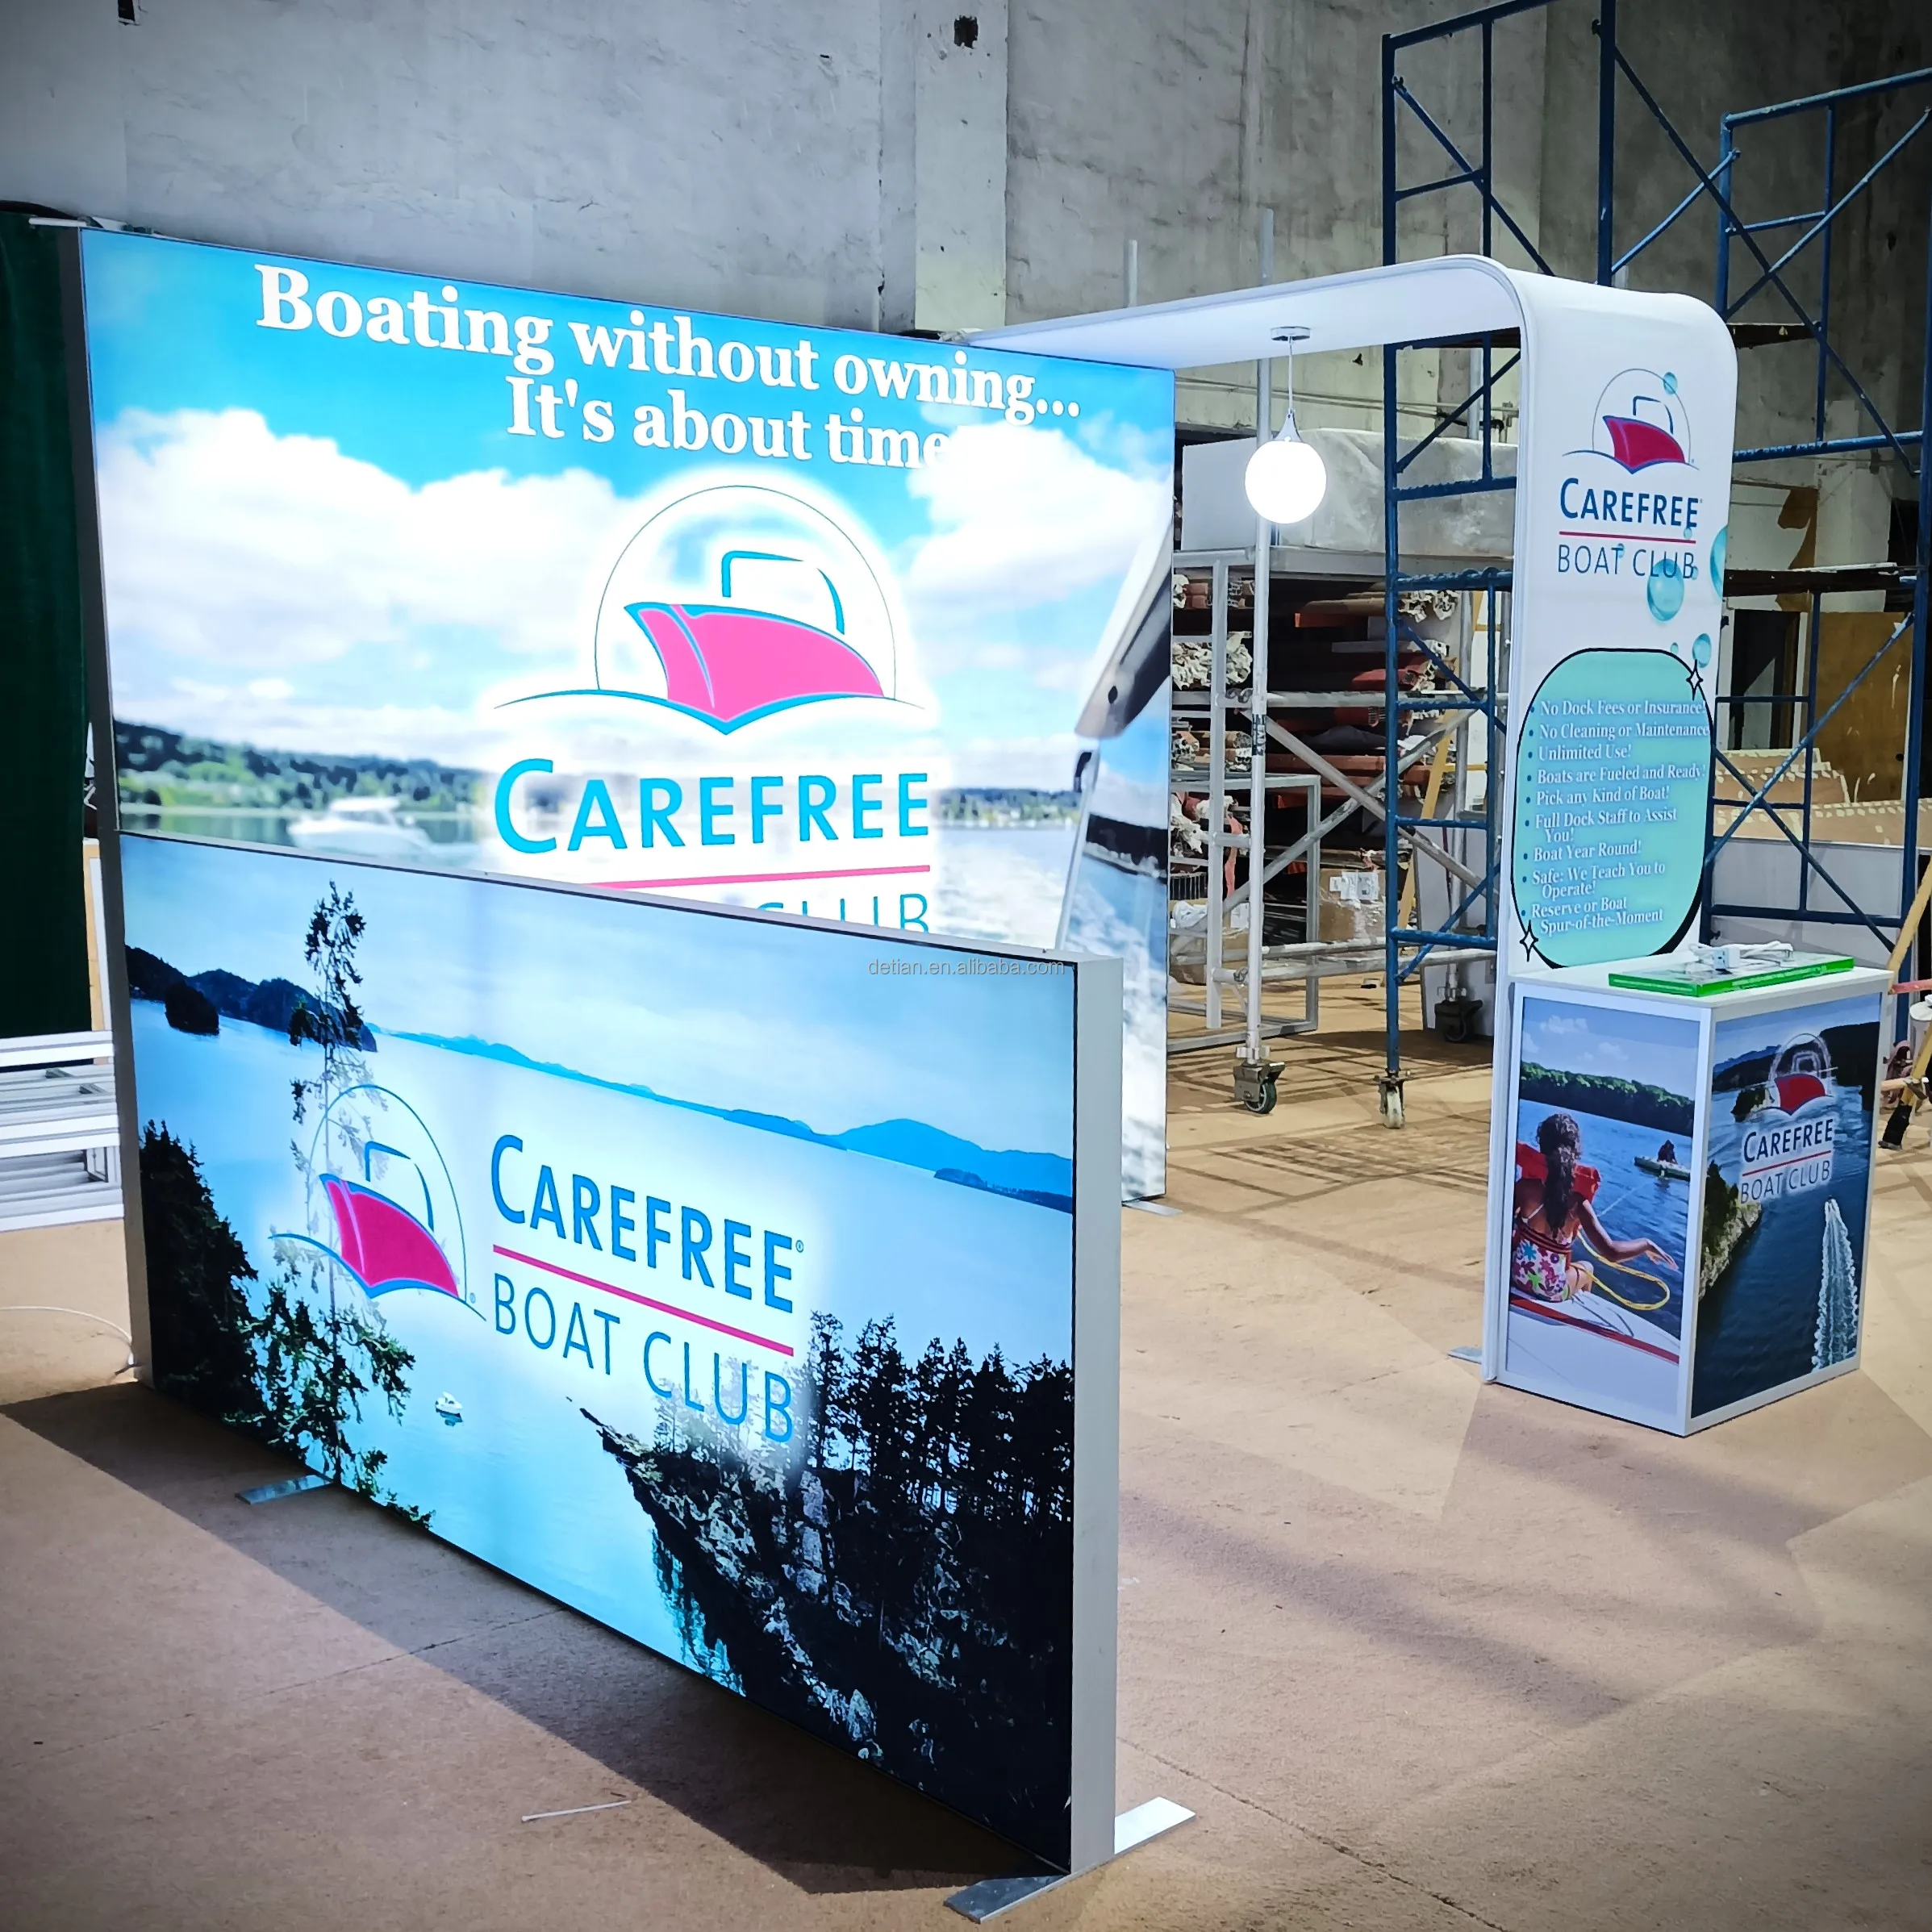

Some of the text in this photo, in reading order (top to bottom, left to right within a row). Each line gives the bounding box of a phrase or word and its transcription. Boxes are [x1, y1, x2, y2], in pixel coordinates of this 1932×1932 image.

[254, 263, 1081, 427] Boating without owning...
[505, 375, 615, 444] It's
[633, 388, 813, 461] about
[1558, 544, 1695, 579] BOAT CLUB
[1540, 699, 1706, 716] No Dock Fees or Insurance!
[1539, 724, 1558, 739] No
[1560, 723, 1616, 741] Cleaning
[1618, 726, 1633, 738] or
[1538, 744, 1632, 761] Unlimited Use!
[1538, 764, 1707, 784] Boats are Fueled and Ready!
[494, 757, 929, 854] CAREFREE
[1536, 786, 1670, 807] Pick any Kind of Boat!
[1535, 806, 1677, 829] Full Dock Staff to Assist
[1545, 828, 1574, 844] You!
[1533, 839, 1642, 862] Boat Year Round!
[1532, 862, 1666, 886] Safe: We Teach You to
[1542, 880, 1596, 901] Operate!
[1531, 897, 1627, 920] Reserve or Boat
[1540, 908, 1663, 937] Spur-of-the-Moment
[1743, 1118, 1834, 1163] CAREFREE
[1740, 1160, 1831, 1204] BOAT CLUB
[494, 1272, 794, 1442] BOAT CLUB
